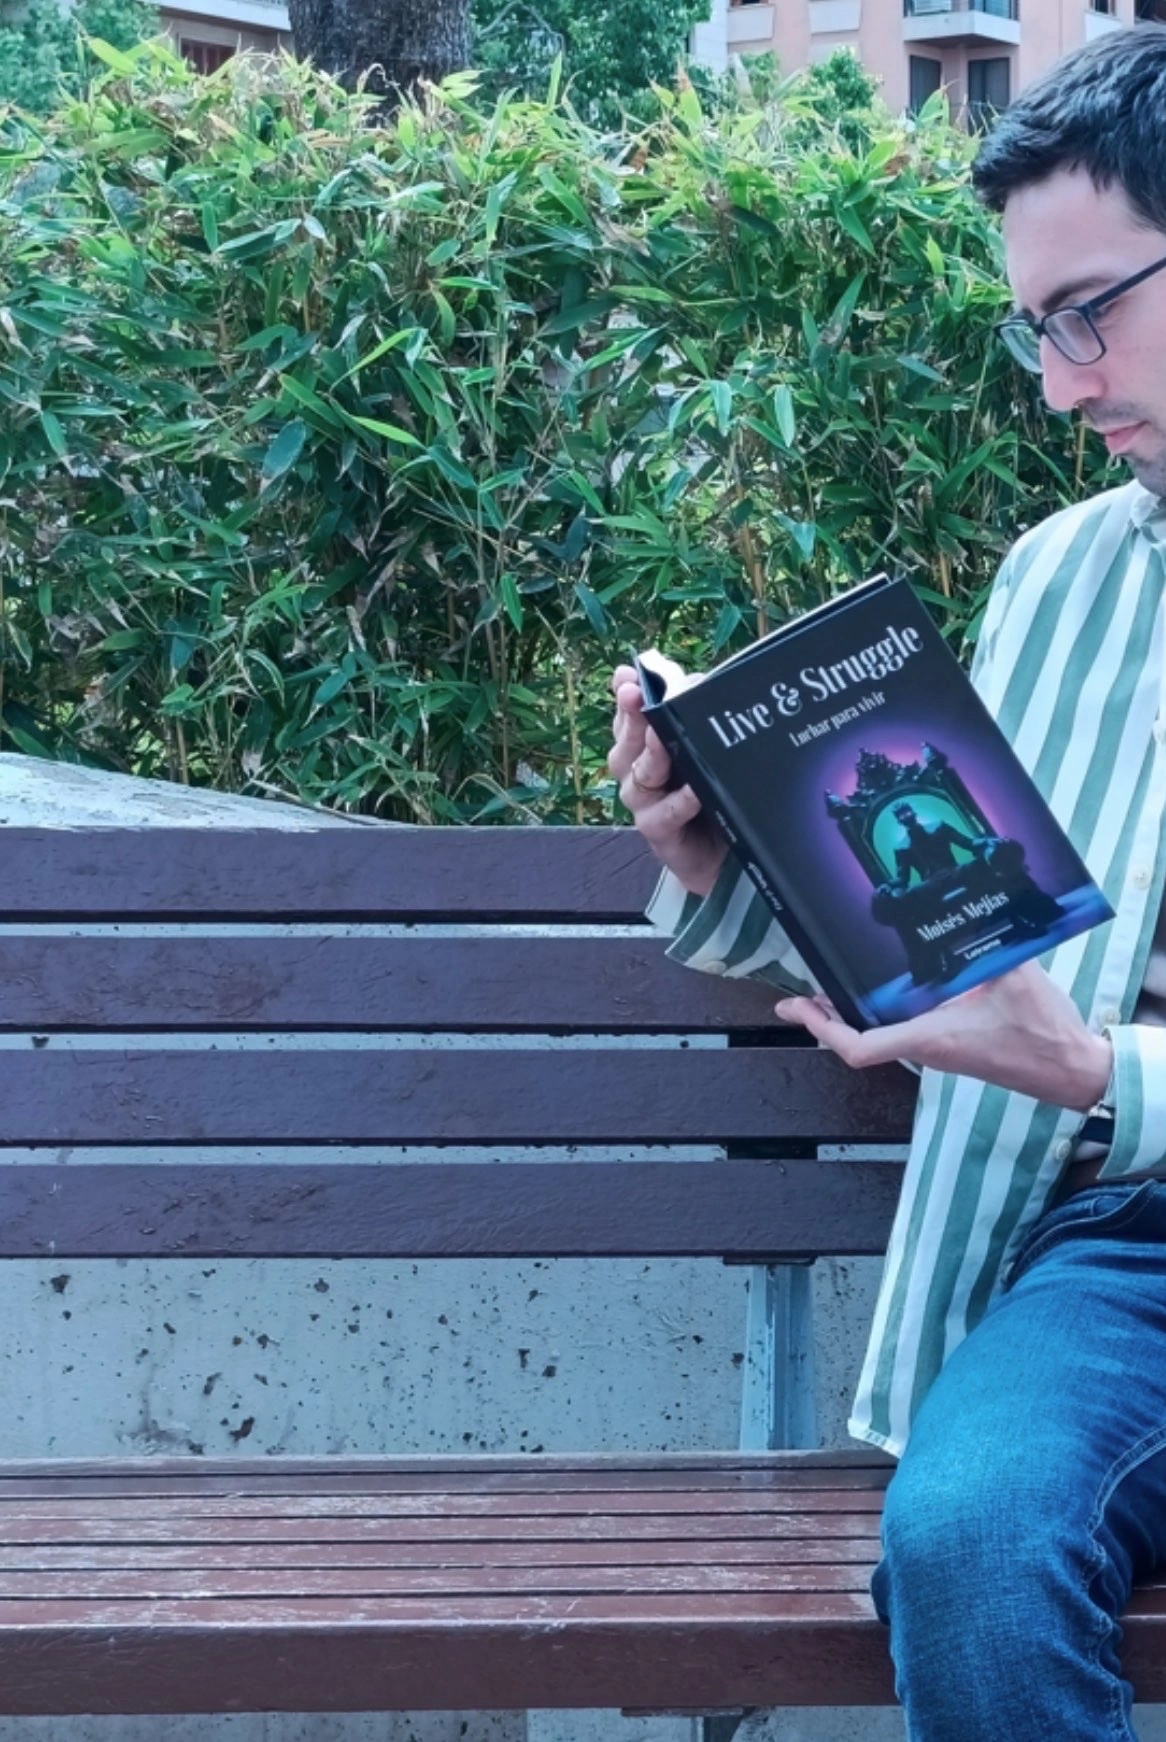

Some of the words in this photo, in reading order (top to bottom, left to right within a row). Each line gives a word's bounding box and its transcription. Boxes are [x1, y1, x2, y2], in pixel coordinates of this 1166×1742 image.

[708, 702, 774, 748] Live
[770, 682, 803, 716] &
[799, 625, 923, 702] Struggle
[789, 720, 831, 747] Luchar
[830, 706, 859, 730] para
[857, 691, 885, 712] vivir
